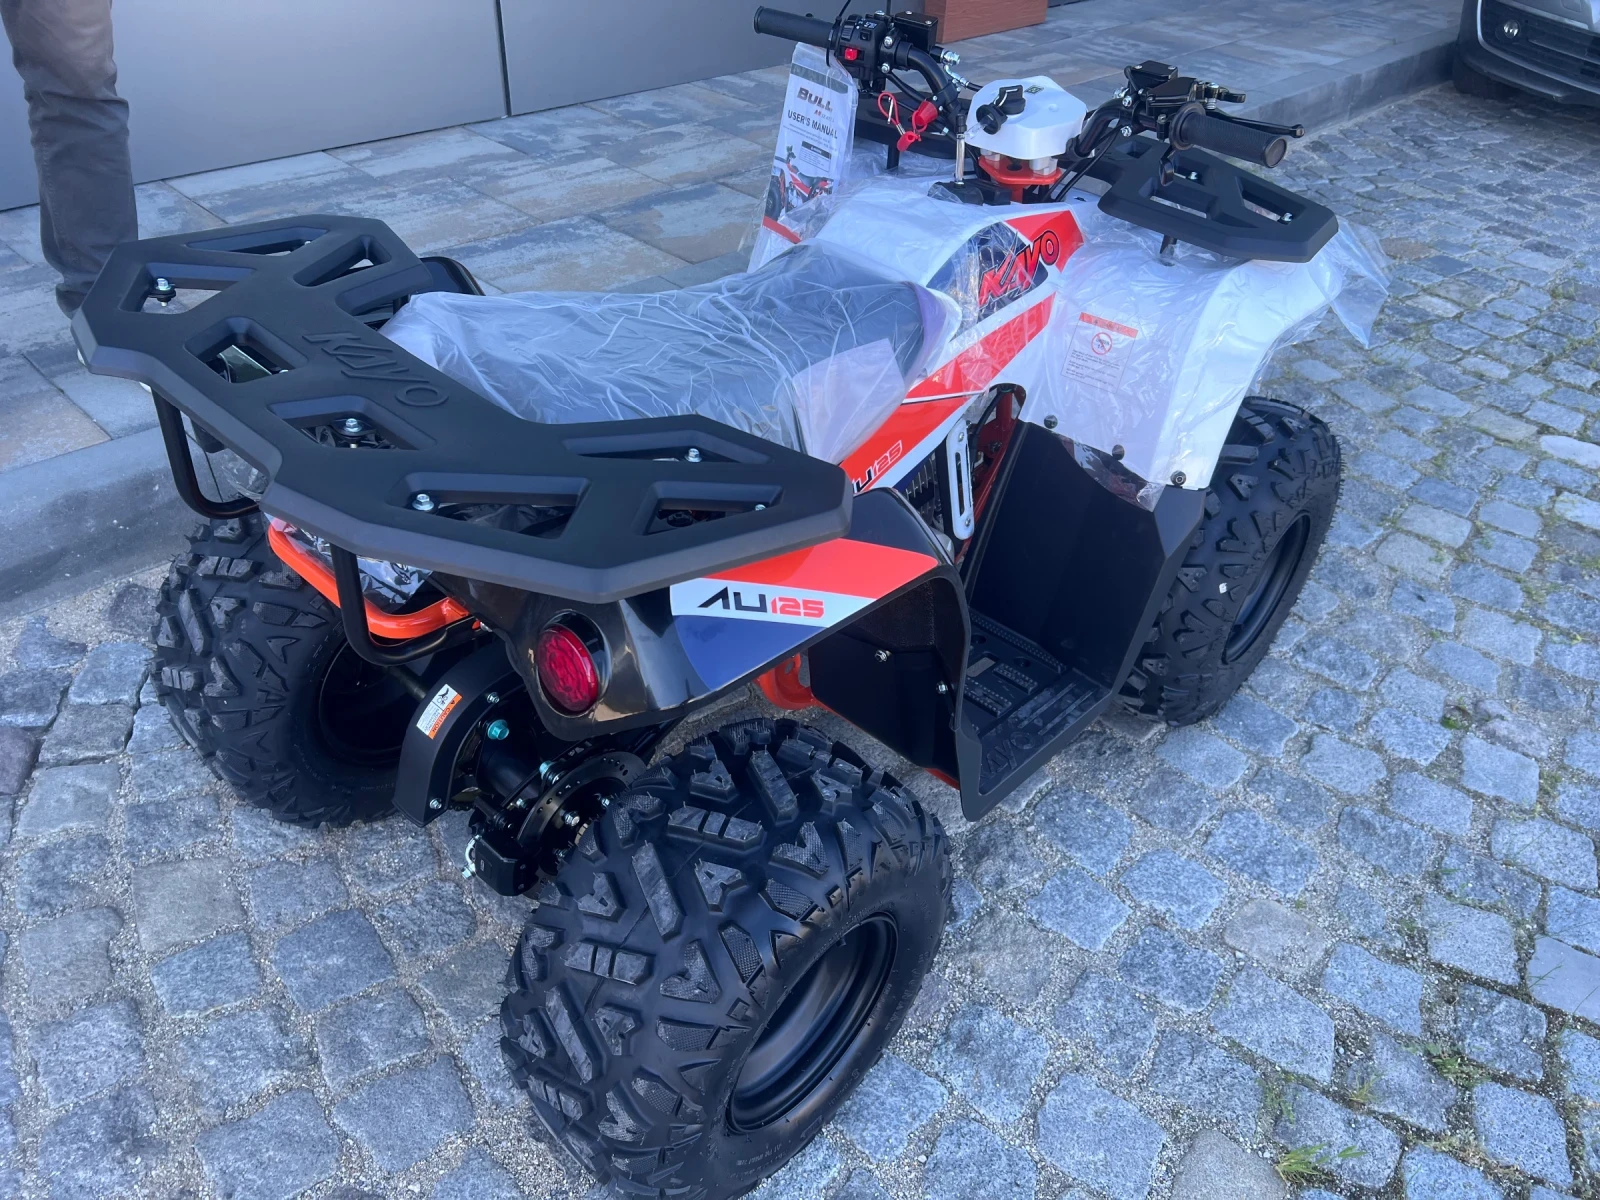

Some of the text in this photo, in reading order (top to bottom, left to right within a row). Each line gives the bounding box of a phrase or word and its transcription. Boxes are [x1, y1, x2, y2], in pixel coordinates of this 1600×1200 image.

[797, 87, 833, 112] BULL
[787, 109, 811, 127] USER'S
[811, 119, 838, 139] MANUAL
[979, 229, 1060, 311] KAYO
[301, 331, 450, 408] KAYO
[851, 440, 903, 494] U125
[697, 585, 825, 620] AU125
